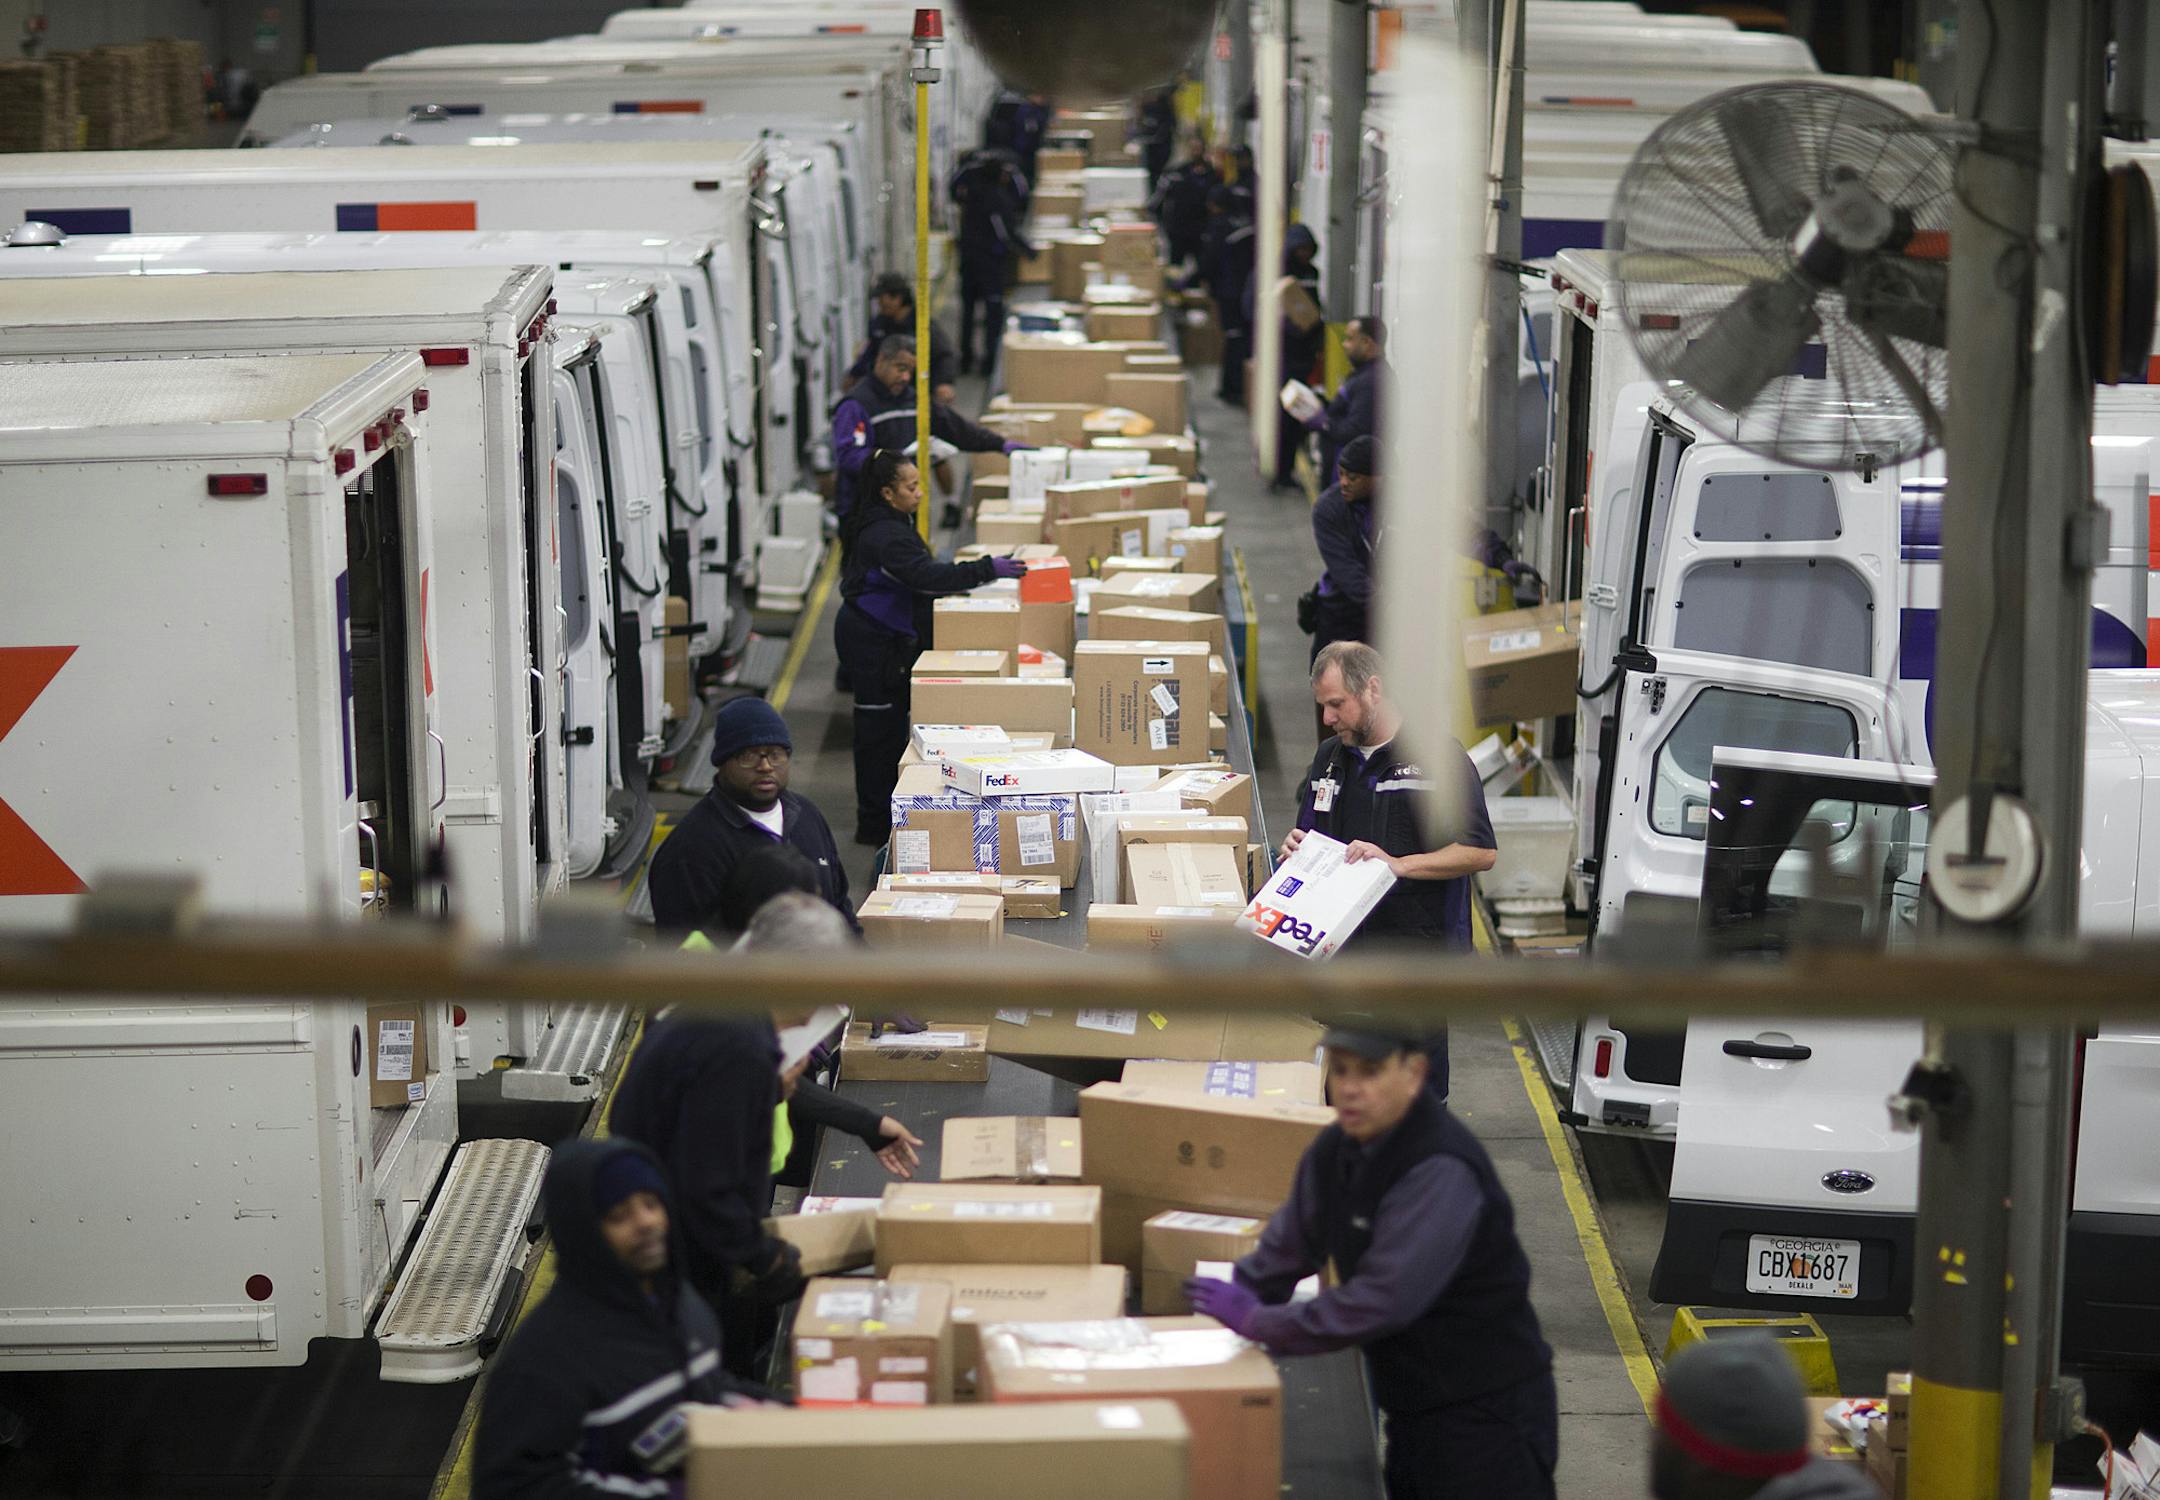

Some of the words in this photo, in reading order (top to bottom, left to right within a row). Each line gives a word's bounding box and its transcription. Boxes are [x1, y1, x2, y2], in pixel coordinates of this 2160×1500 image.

[1154, 726, 1163, 745] AIR
[941, 763, 957, 780] FedEx
[986, 774, 1020, 787] FedEx
[1247, 900, 1326, 956] FedEx
[1834, 1176, 1862, 1189] Ford
[1775, 1239, 1834, 1253] GEORGIA
[1759, 1250, 1849, 1281] CBX1687
[1788, 1281, 1814, 1290] DEKALB
